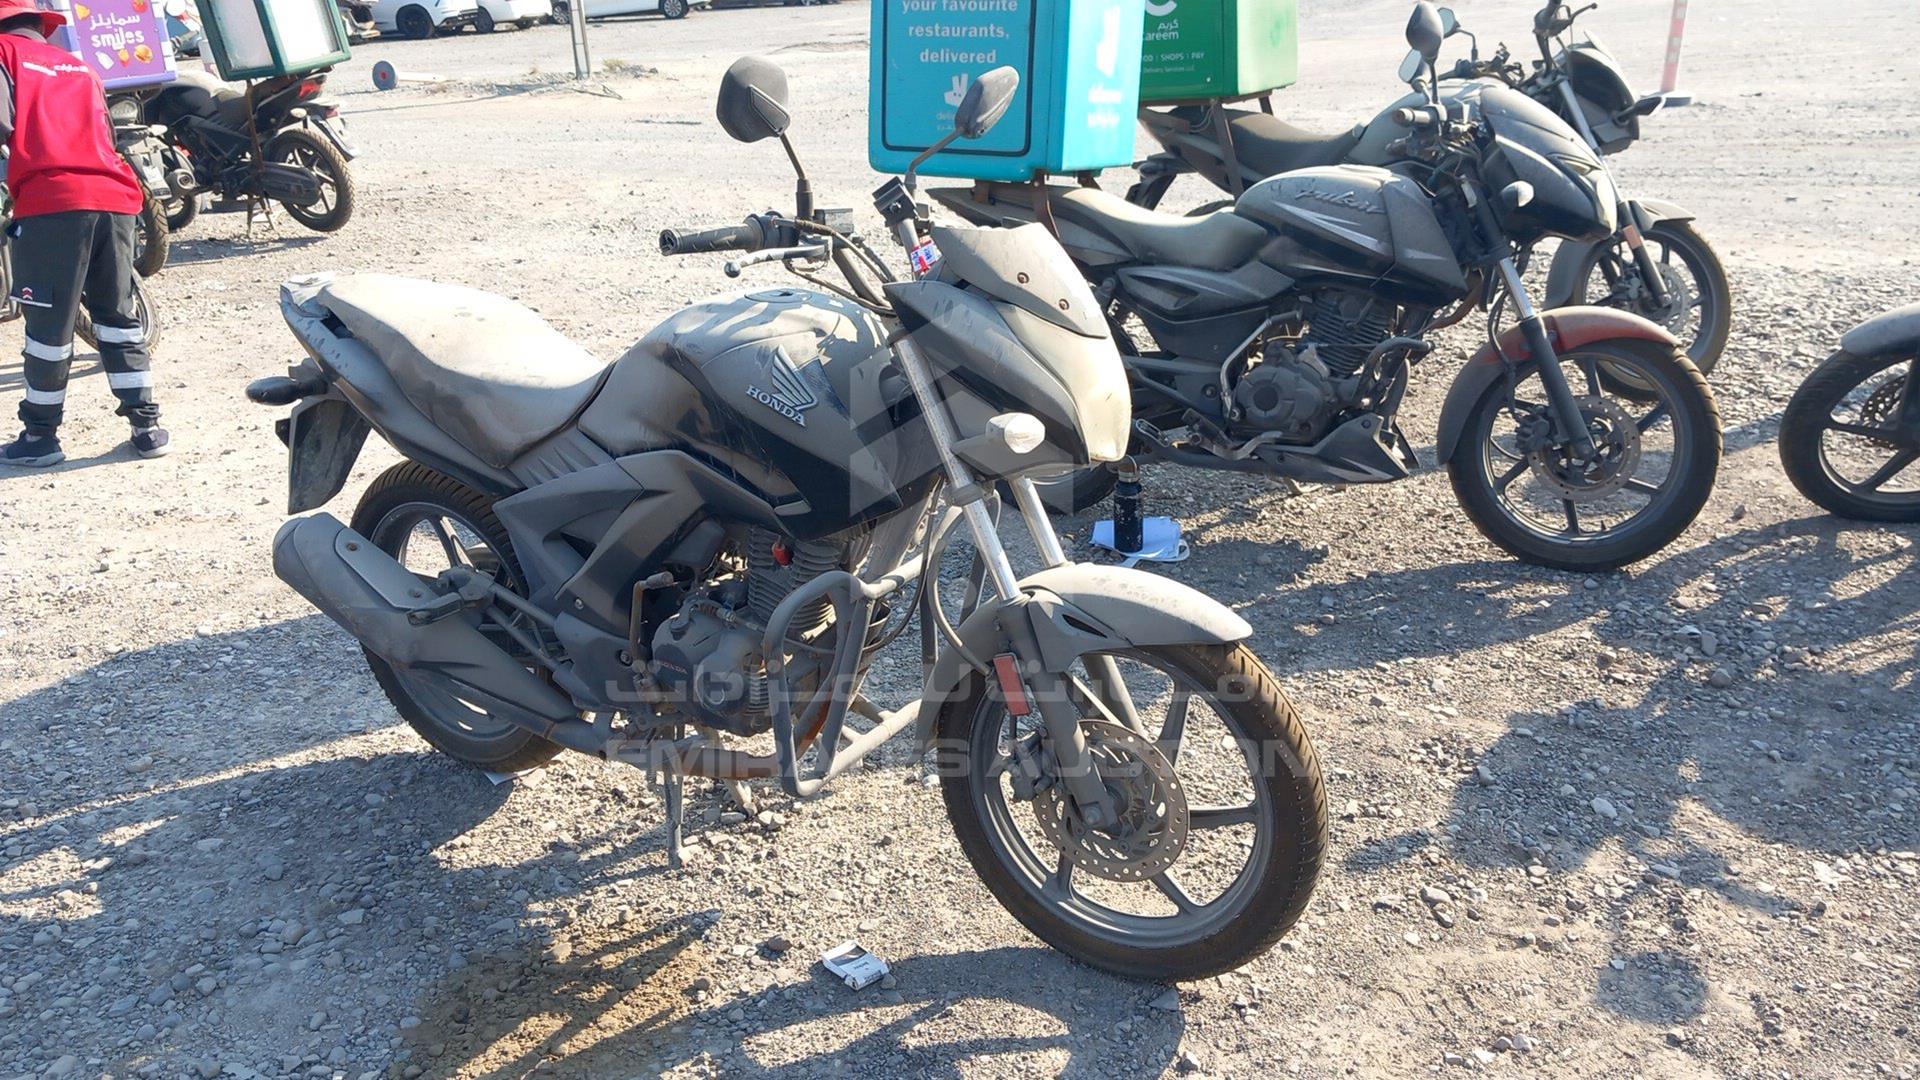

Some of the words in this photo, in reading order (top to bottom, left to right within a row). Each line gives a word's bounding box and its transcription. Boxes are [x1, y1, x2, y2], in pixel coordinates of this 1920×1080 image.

[902, 0, 936, 14] your
[942, 0, 1018, 11] favourite
[90, 13, 140, 30] سمايلز
[1157, 19, 1179, 31] كريم
[908, 23, 1010, 38] restaurants,
[1144, 31, 1179, 41] areem
[91, 27, 145, 50] smiles
[920, 49, 997, 63] delivered
[745, 384, 806, 427] HONDA
